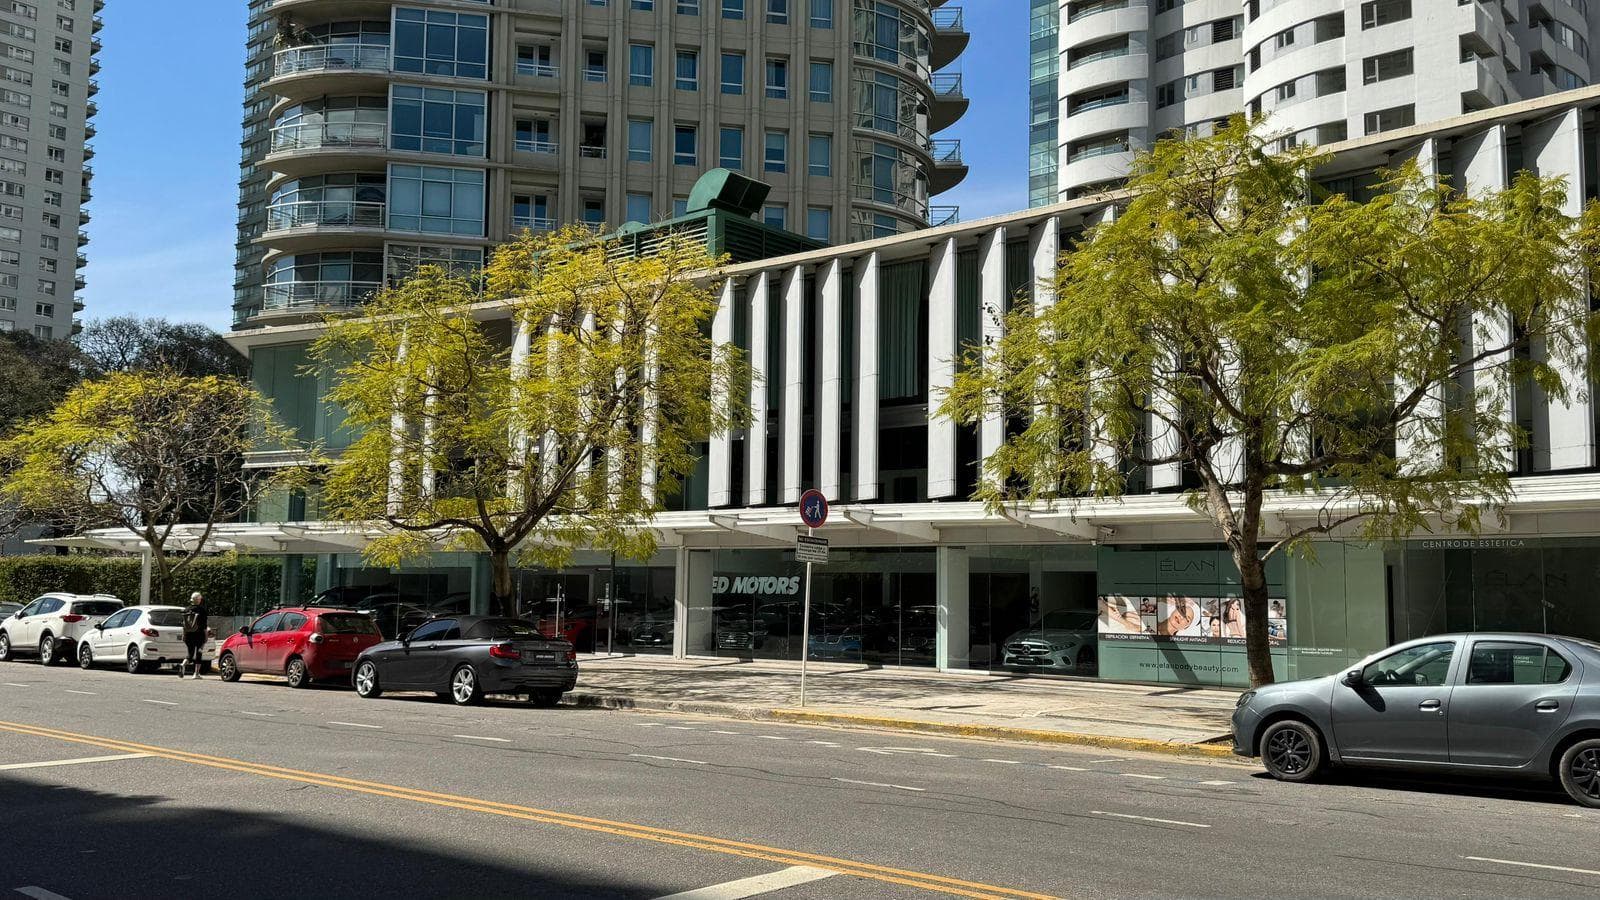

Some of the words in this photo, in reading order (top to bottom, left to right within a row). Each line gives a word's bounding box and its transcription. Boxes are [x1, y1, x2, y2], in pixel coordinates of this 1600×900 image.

[1422, 540, 1461, 549] CENTRO
[1462, 540, 1475, 548] DE
[731, 575, 801, 595] MOTORS
